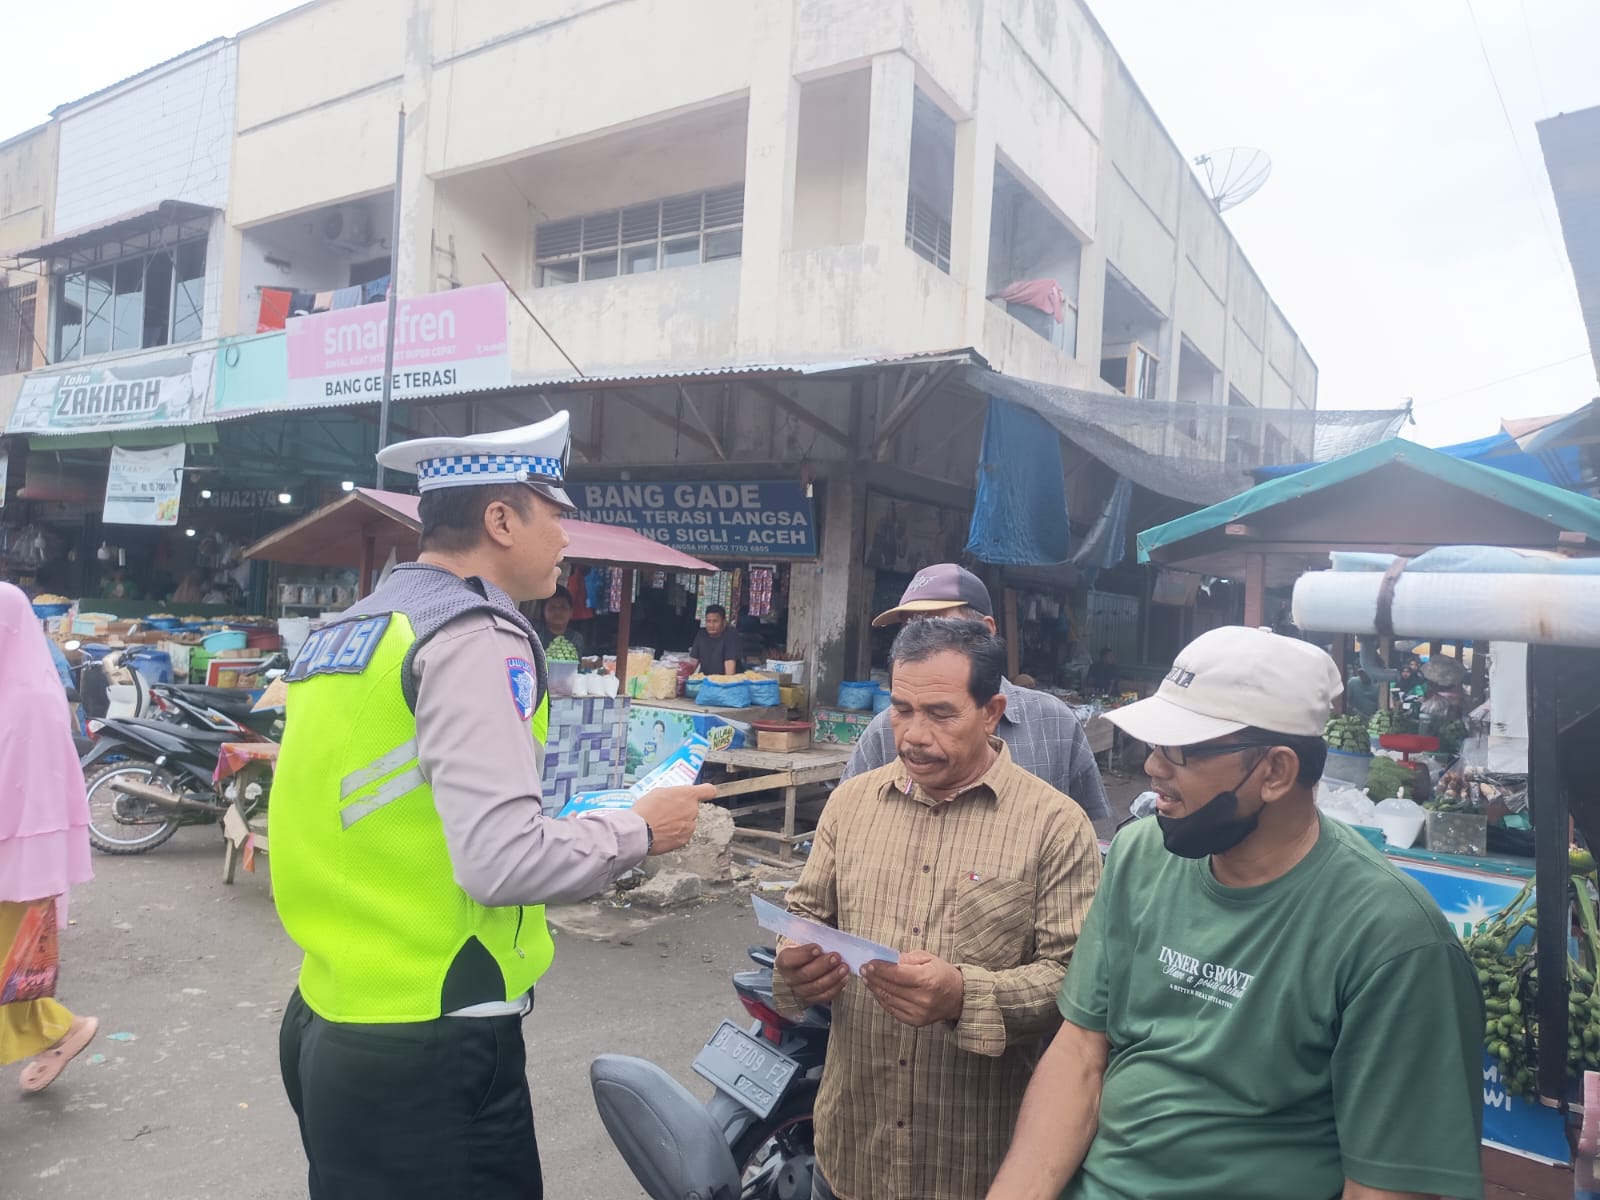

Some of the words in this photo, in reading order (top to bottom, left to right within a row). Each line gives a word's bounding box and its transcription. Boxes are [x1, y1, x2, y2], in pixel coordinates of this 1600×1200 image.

[325, 304, 455, 355] smarfren
[63, 374, 91, 386] Toko
[325, 378, 361, 396] BANG
[364, 373, 401, 392] GEE
[404, 368, 457, 388] TERASI
[57, 379, 161, 416] ZAKIRAH
[586, 485, 665, 508] BANG
[674, 484, 761, 509] GADE
[642, 510, 712, 525] TERASI
[719, 511, 807, 526] LANGSA
[676, 528, 728, 543] SIGLI
[747, 530, 807, 544] ACEH
[1159, 946, 1199, 975] INNER
[732, 1041, 766, 1072] 6709
[765, 1064, 788, 1089] FZ
